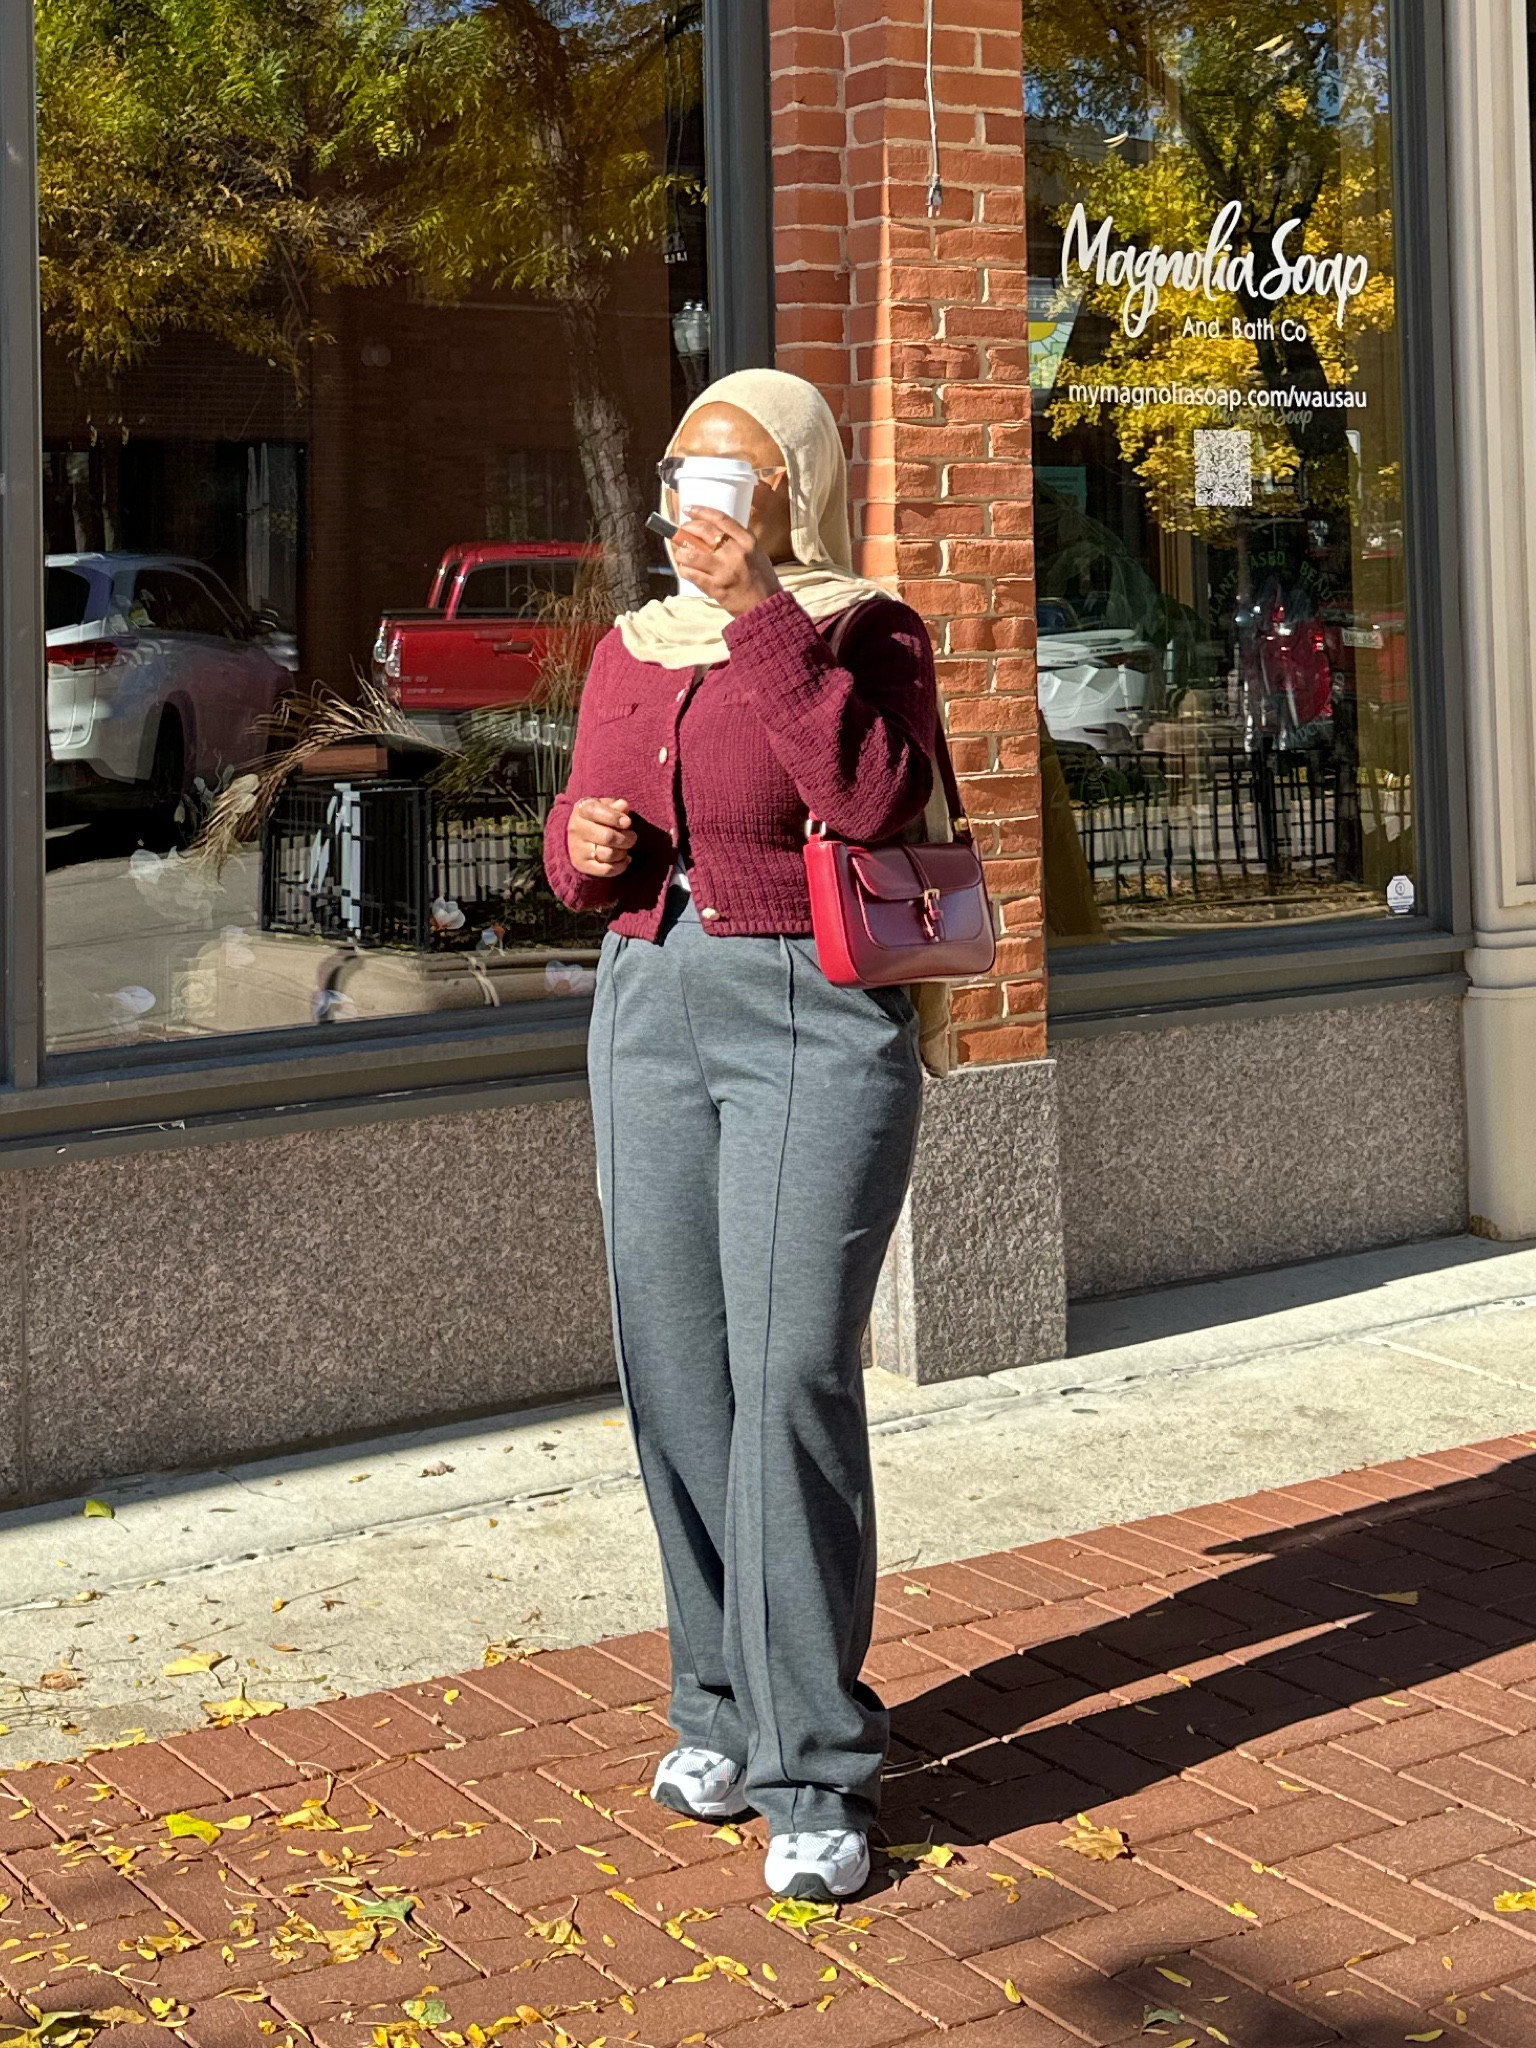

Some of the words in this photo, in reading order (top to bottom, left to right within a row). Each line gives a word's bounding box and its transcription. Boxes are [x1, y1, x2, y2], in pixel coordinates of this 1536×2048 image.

[1061, 200, 1259, 338] Magnolia
[1259, 217, 1368, 329] Soap
[1182, 317, 1220, 339] And
[1231, 317, 1275, 341] Bath
[1280, 319, 1307, 342] Co
[1068, 384, 1367, 411] mymagnoliasoap.com/wausau
[1245, 550, 1287, 569] ASED
